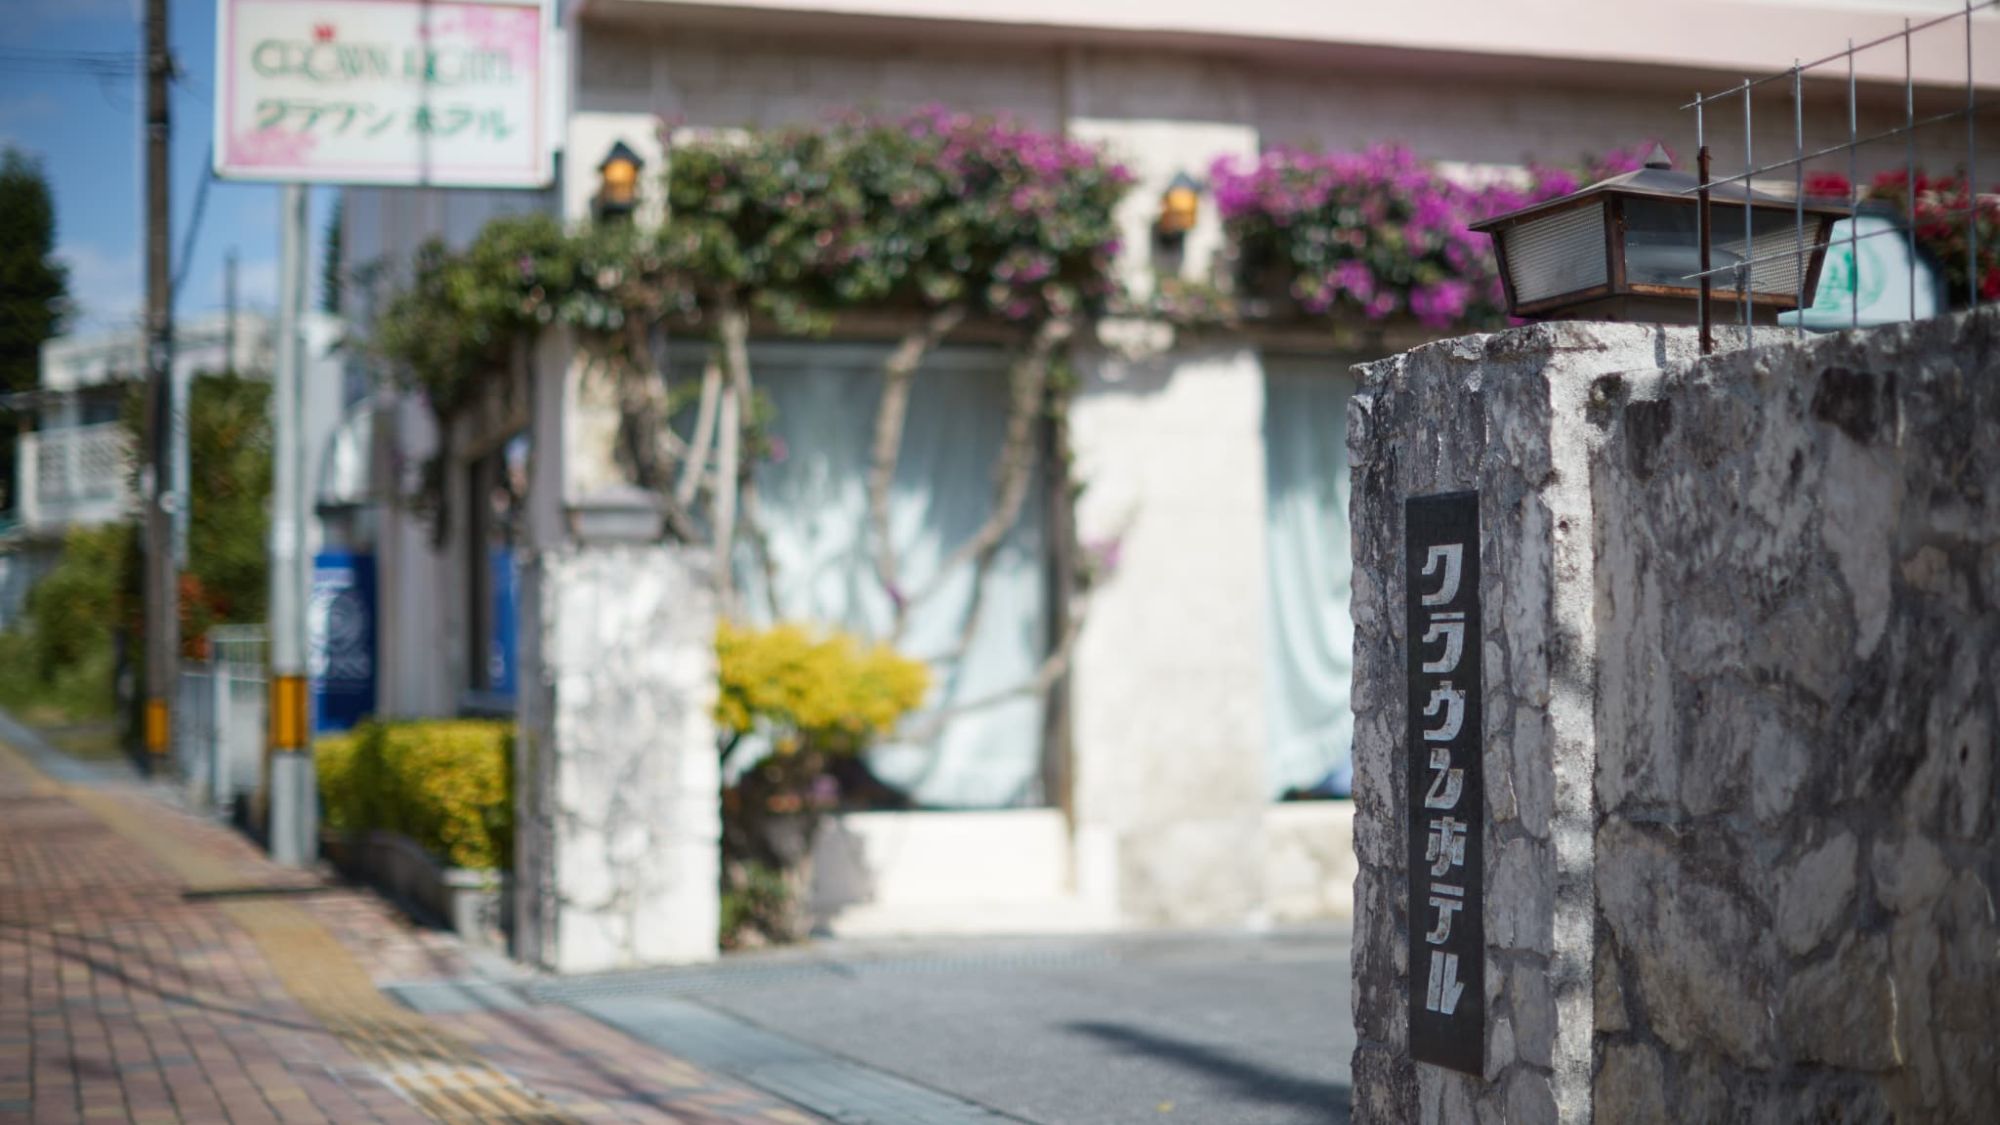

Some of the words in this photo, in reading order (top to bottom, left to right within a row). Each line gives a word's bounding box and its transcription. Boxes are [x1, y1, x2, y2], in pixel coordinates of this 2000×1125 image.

[1421, 543, 1467, 1016] クラウンホテル
